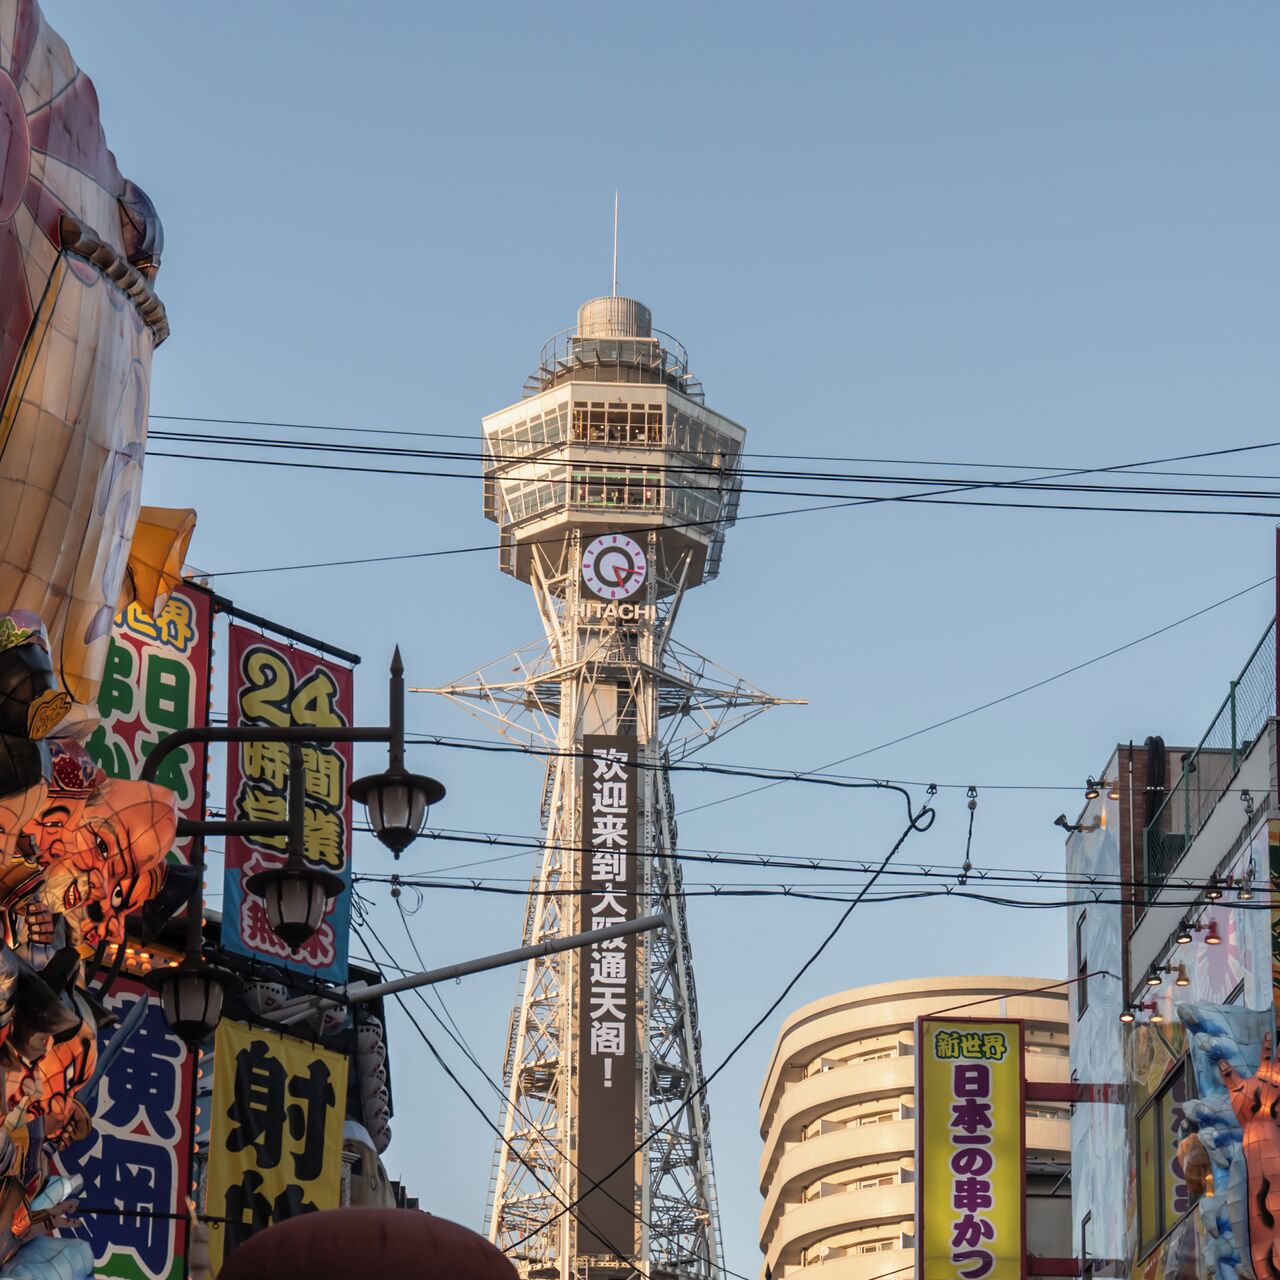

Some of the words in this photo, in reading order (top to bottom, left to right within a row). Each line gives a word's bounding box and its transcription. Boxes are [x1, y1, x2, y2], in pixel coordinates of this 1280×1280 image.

[115, 596, 194, 650] 世界
[570, 602, 656, 620] HITACHI
[936, 1031, 1006, 1061] 新世界
[951, 1064, 994, 1278] 日本一の串かつ
